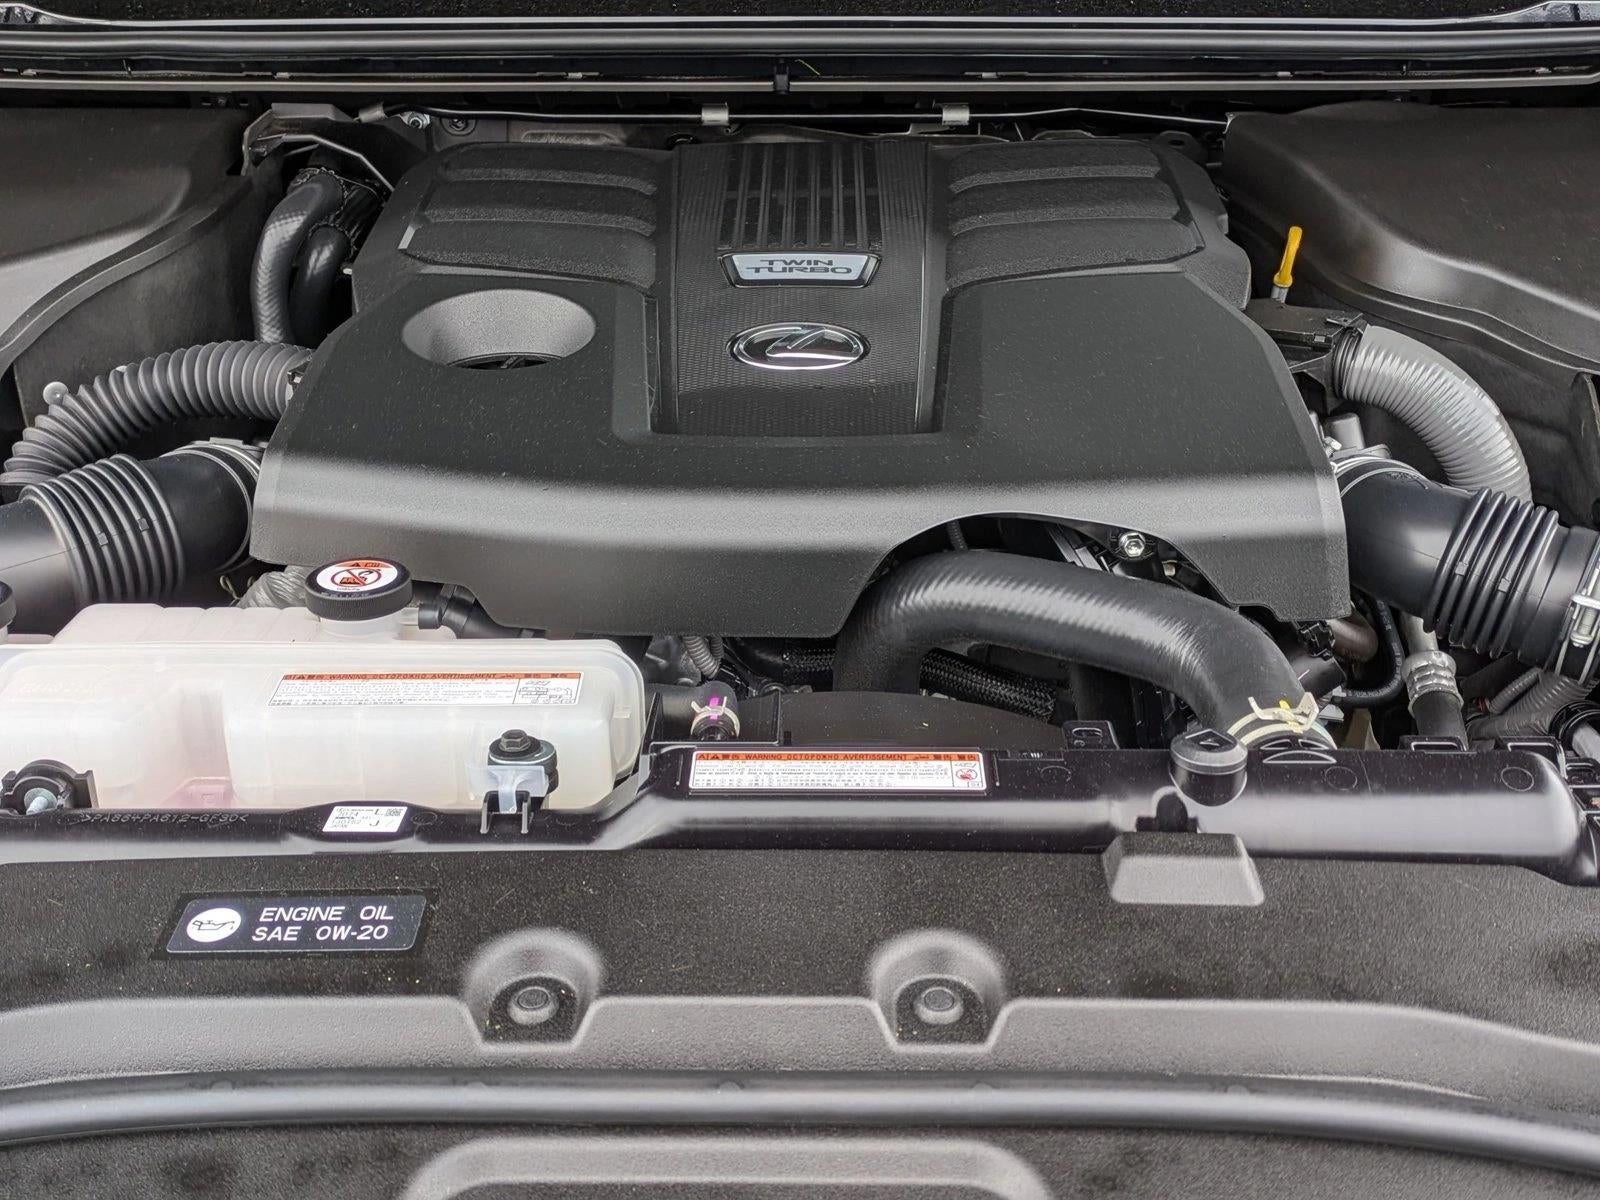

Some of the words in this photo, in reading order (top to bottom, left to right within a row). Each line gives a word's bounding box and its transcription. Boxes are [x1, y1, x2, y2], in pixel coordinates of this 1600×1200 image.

[745, 266, 853, 274] TURBO
[430, 672, 498, 680] AVERTISSEMENT
[744, 753, 783, 761] WARNING
[842, 753, 908, 761] AVERTISSEMENT
[259, 905, 346, 923] ENGINE
[358, 905, 395, 921] OIL
[251, 925, 302, 943] SAE
[315, 924, 390, 942] 0W-20
